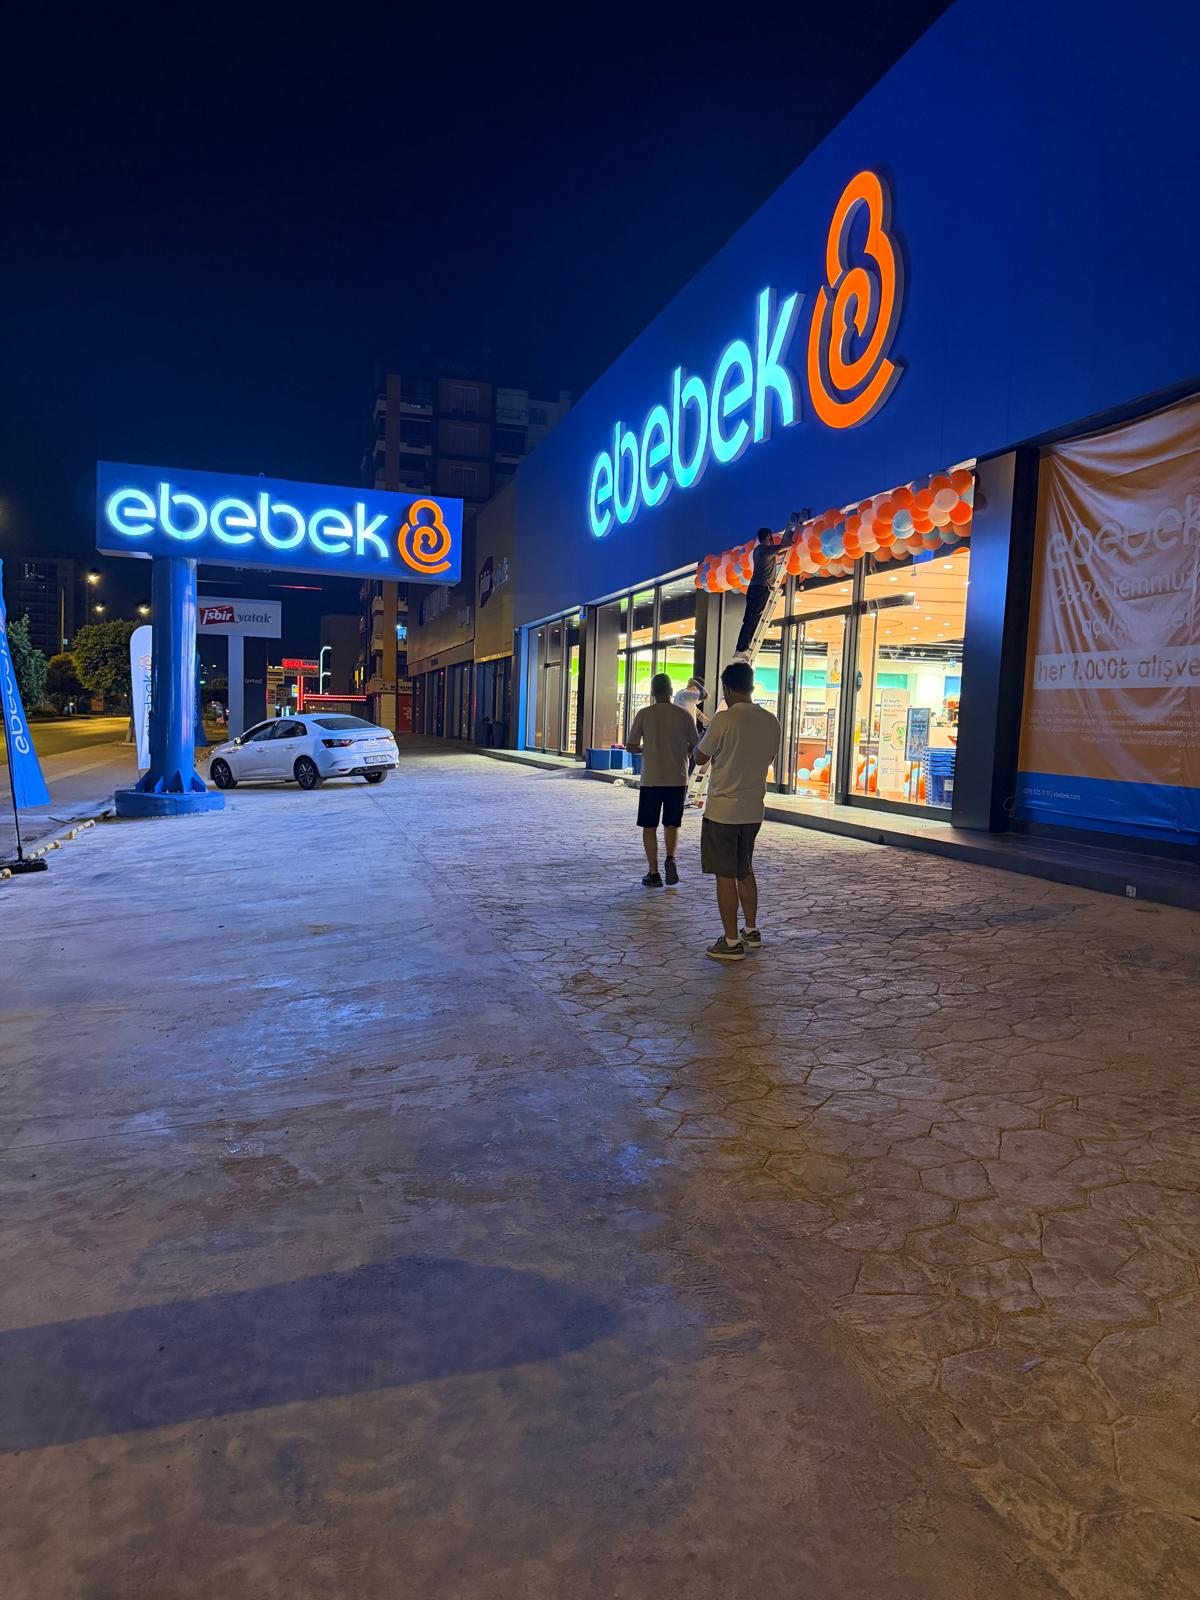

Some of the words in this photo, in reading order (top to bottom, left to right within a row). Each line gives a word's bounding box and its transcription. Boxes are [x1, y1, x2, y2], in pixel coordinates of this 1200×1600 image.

[589, 286, 804, 539] ebebek
[106, 482, 391, 558] ebebek
[1038, 660, 1067, 682] her
